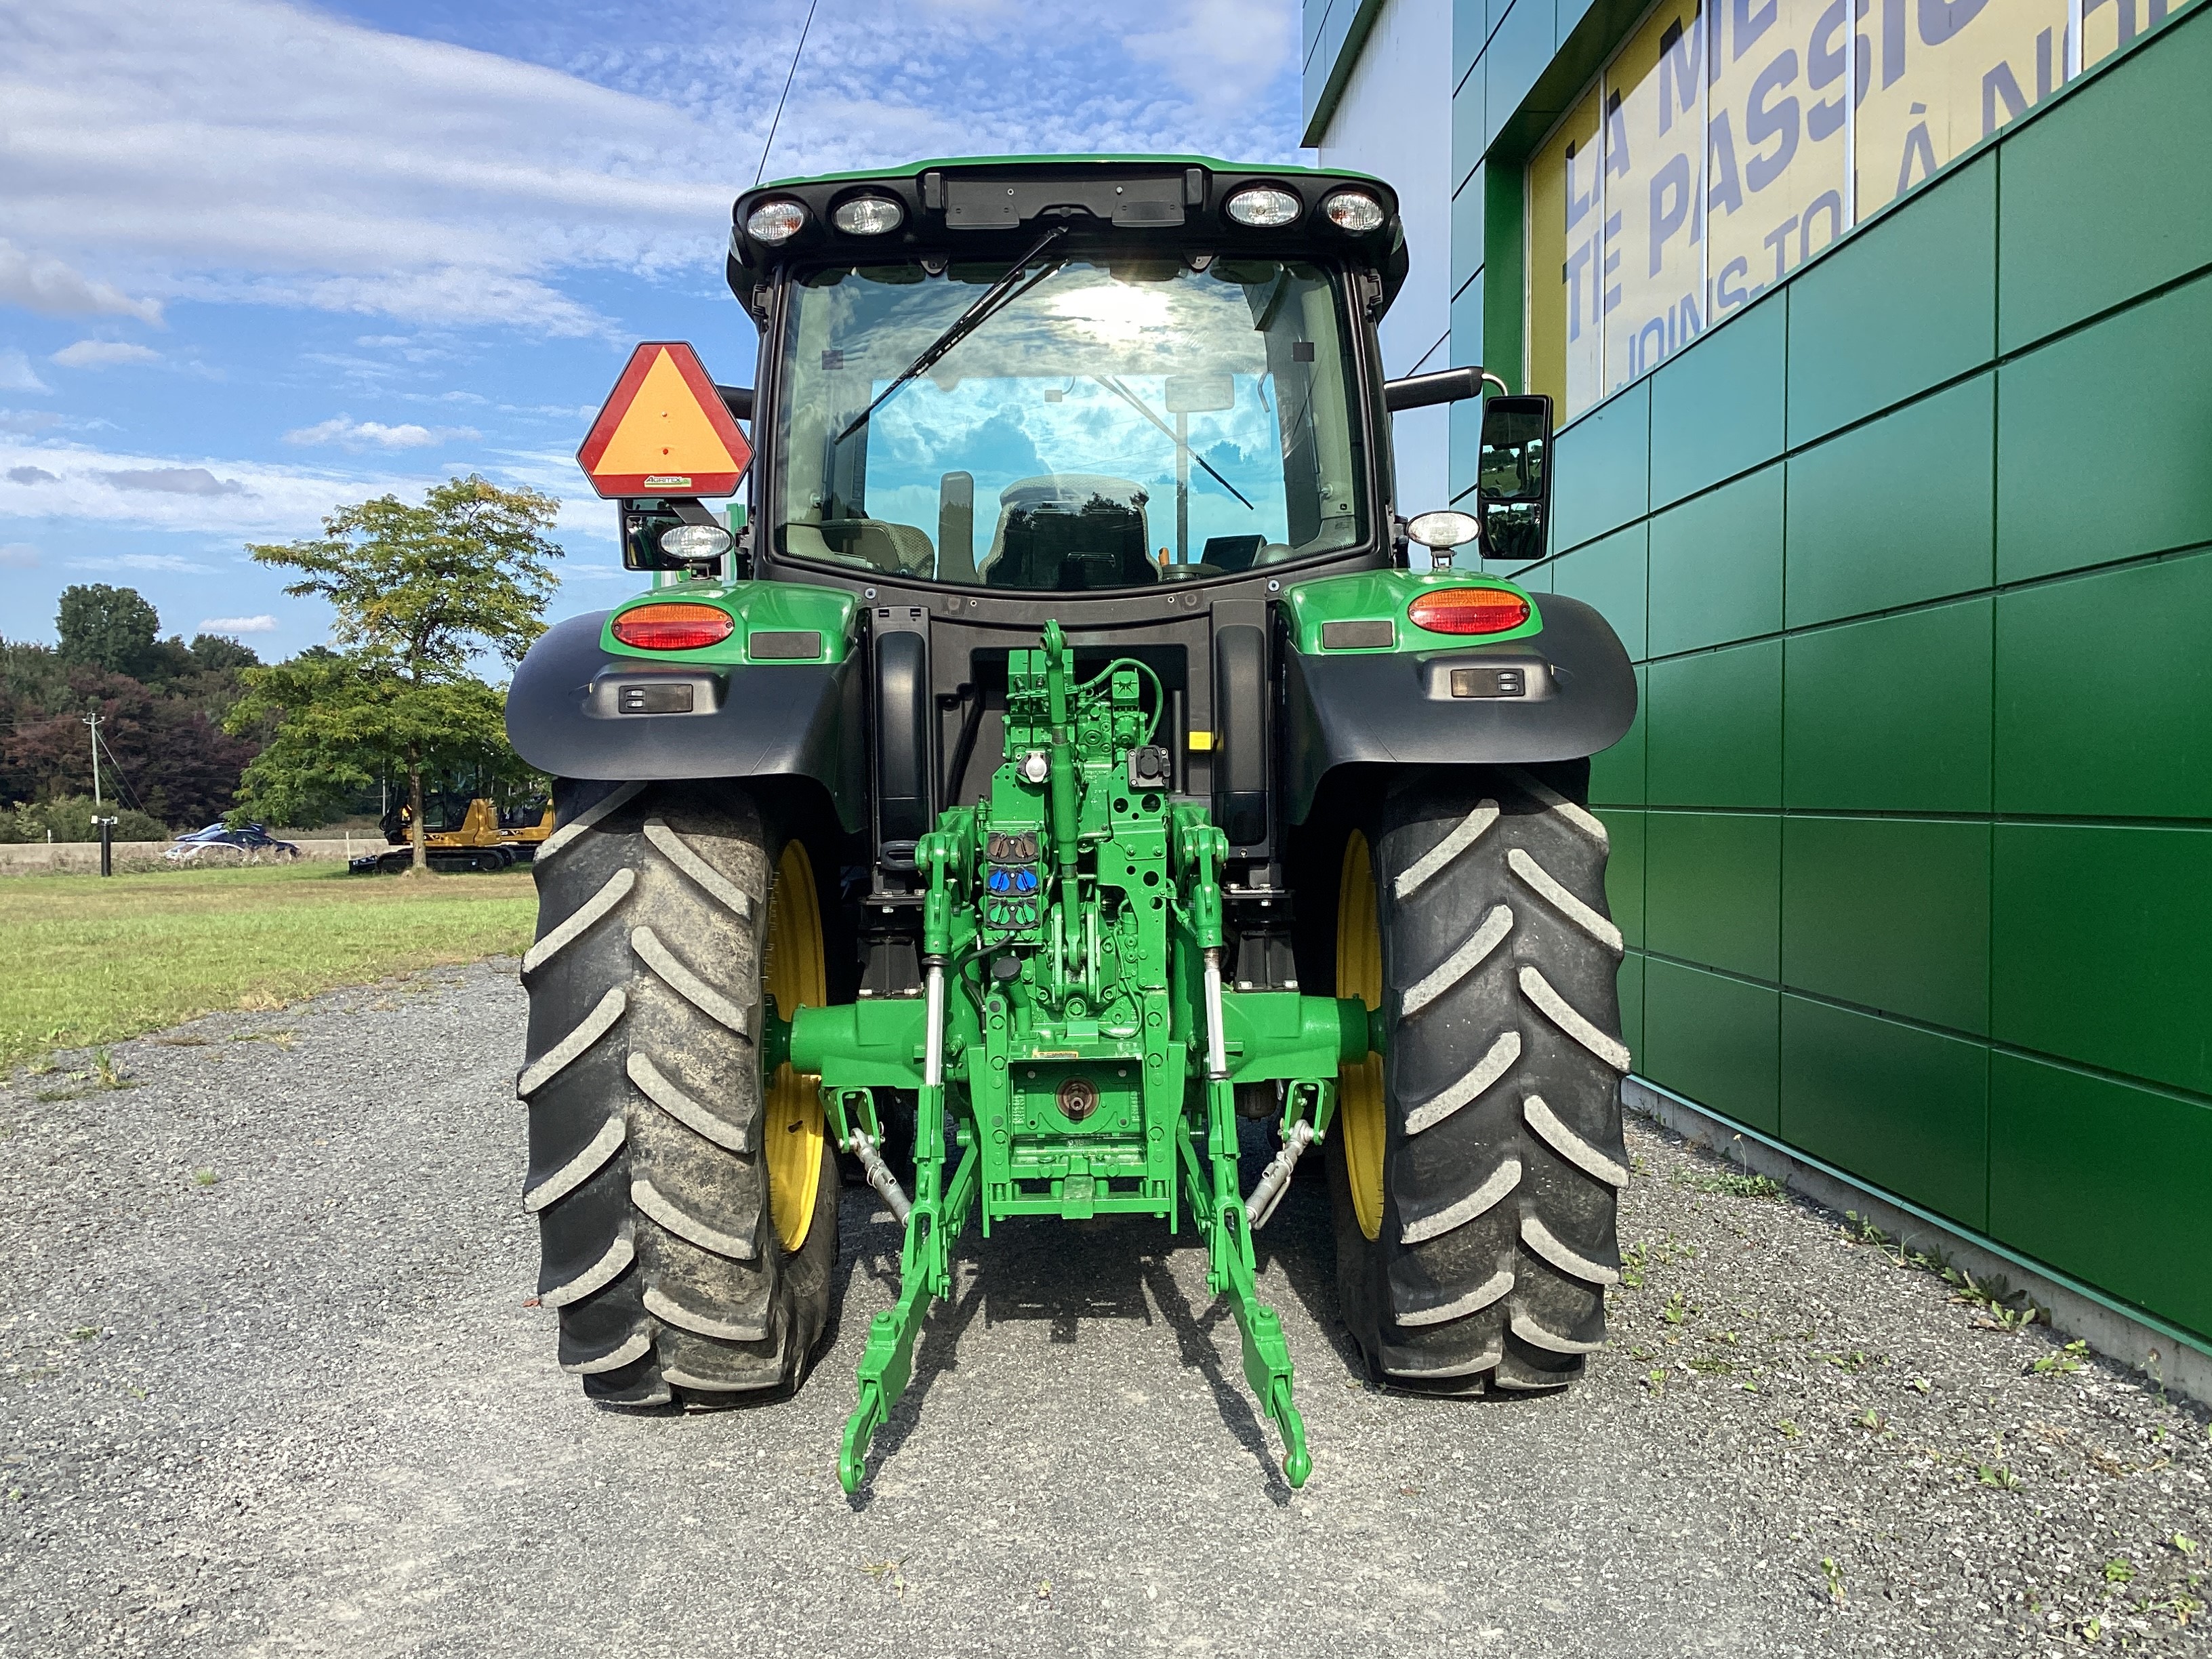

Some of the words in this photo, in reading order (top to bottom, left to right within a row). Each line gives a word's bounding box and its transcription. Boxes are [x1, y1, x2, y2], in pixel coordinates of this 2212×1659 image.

[1565, 89, 1630, 234] LA
[1896, 102, 1938, 197] À
[1562, 209, 1622, 344] TE
